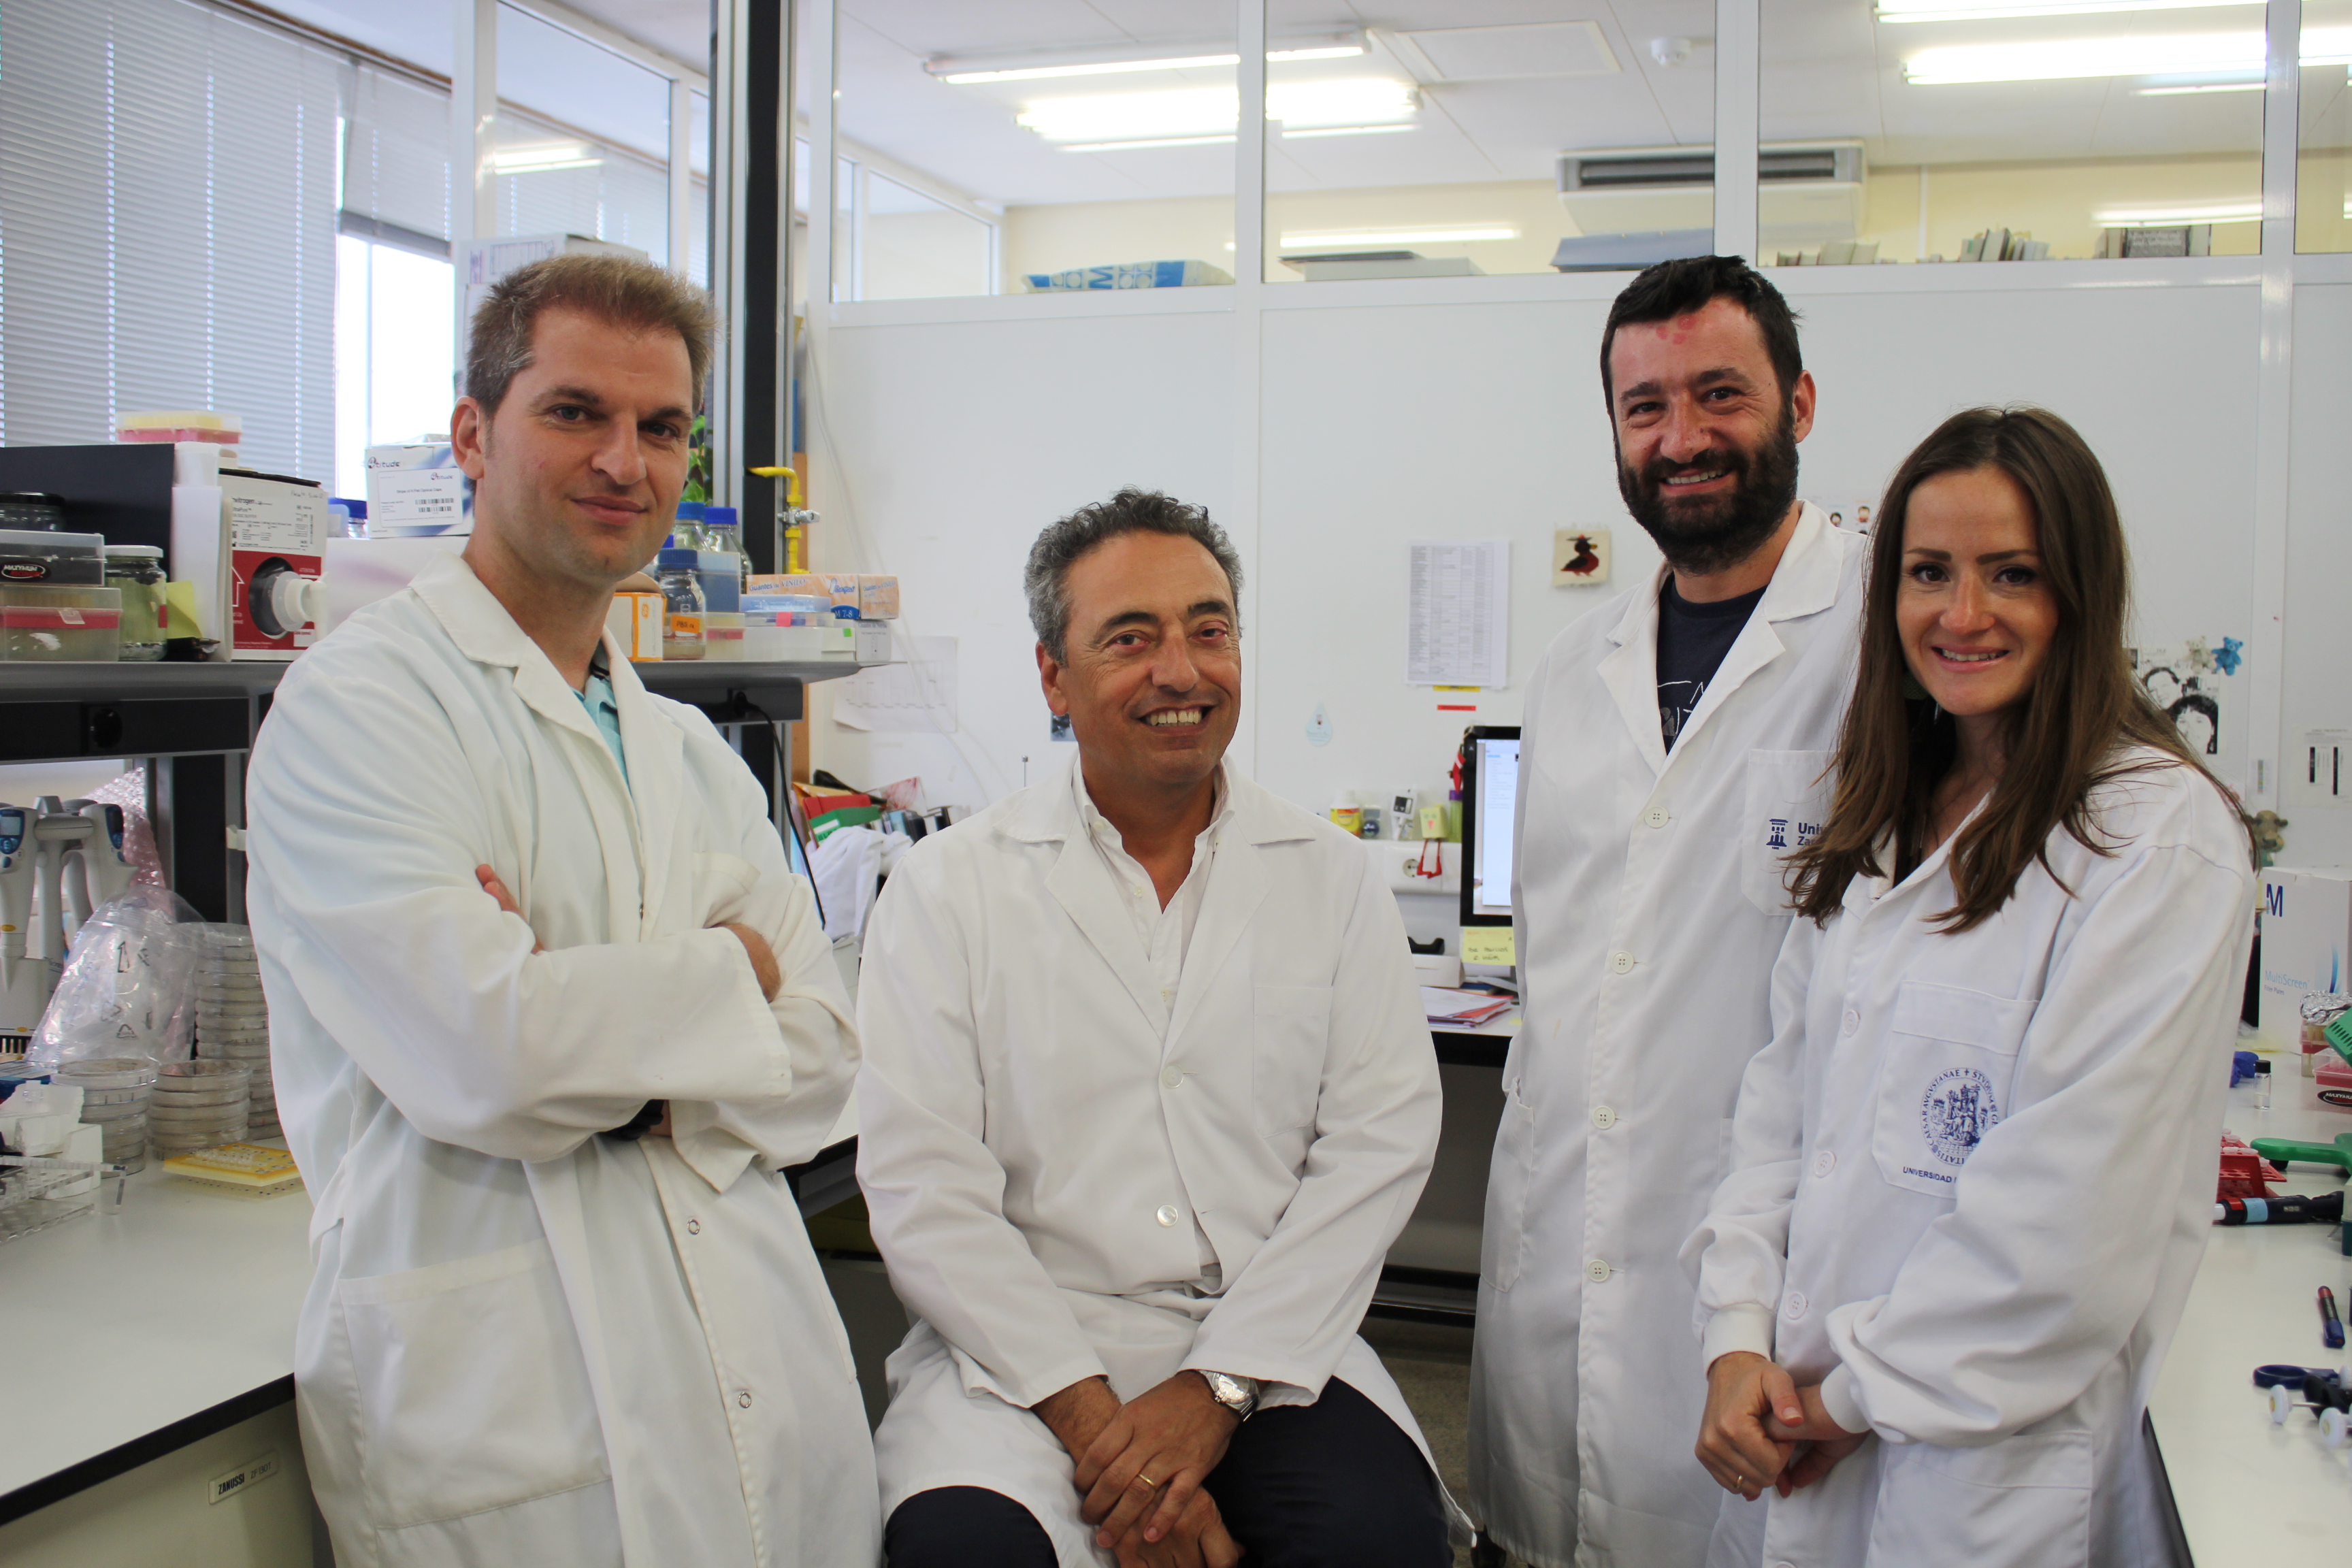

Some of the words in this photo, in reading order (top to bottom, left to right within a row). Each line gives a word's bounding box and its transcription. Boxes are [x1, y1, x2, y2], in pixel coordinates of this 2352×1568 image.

[749, 583, 772, 591] Guantes
[781, 578, 806, 587] VINILO
[1902, 1166, 1953, 1183] UNIVERSIDAD
[218, 1472, 246, 1496] ZANUSSI
